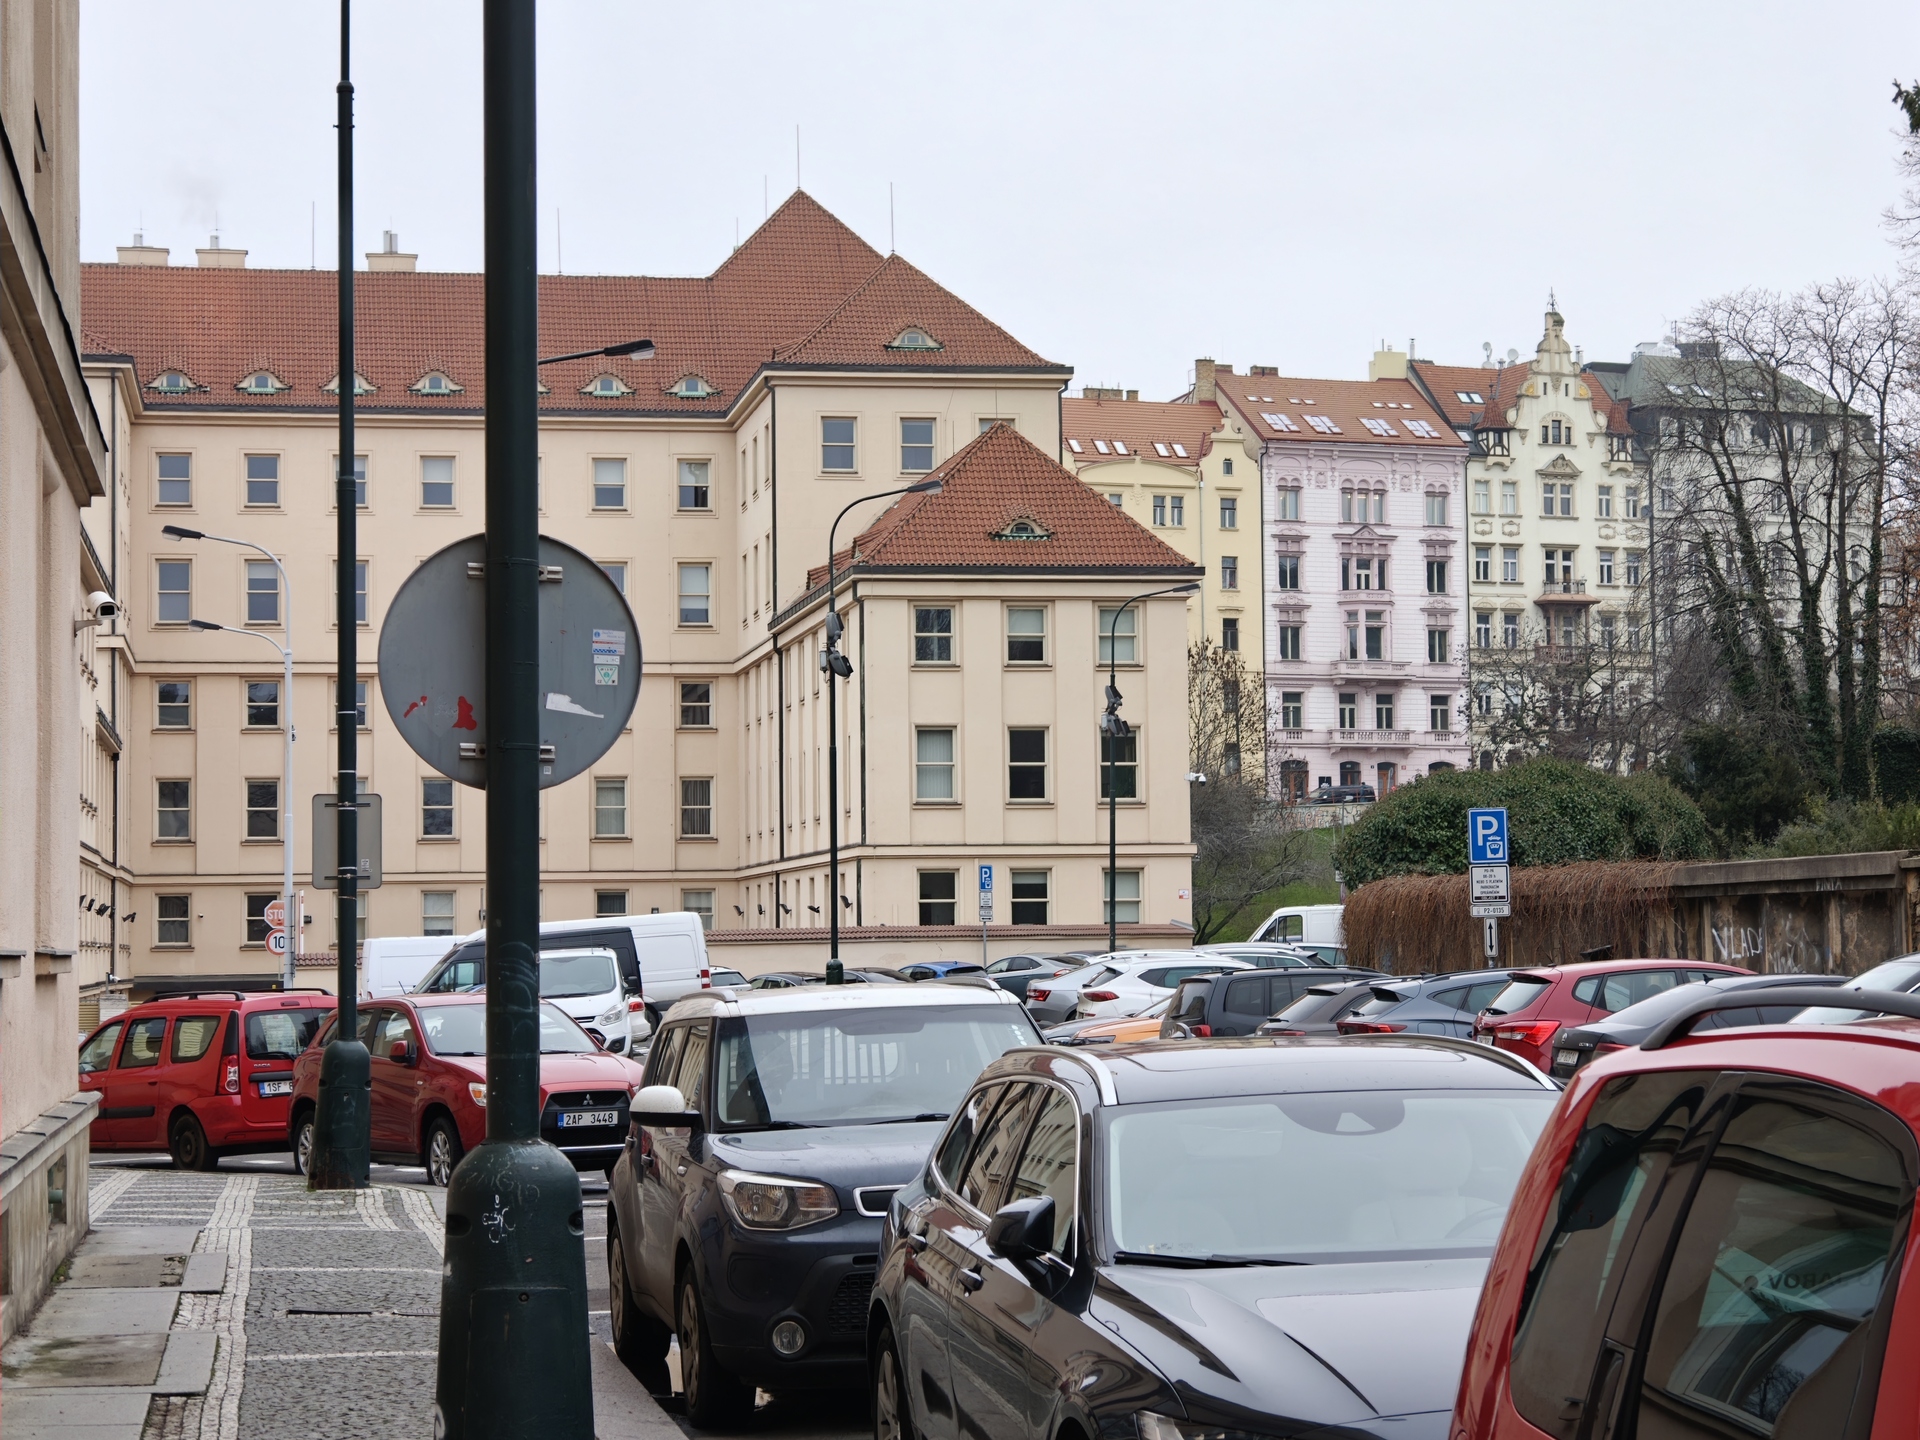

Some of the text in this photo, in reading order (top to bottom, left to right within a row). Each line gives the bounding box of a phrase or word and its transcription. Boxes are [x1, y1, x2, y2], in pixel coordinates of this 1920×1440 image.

[1476, 815, 1499, 846] P
[981, 867, 990, 883] P
[267, 909, 284, 920] STO
[273, 935, 285, 949] 10
[267, 1082, 282, 1092] 1SF
[566, 1114, 583, 1125] 2AP
[591, 1112, 613, 1124] 3448
